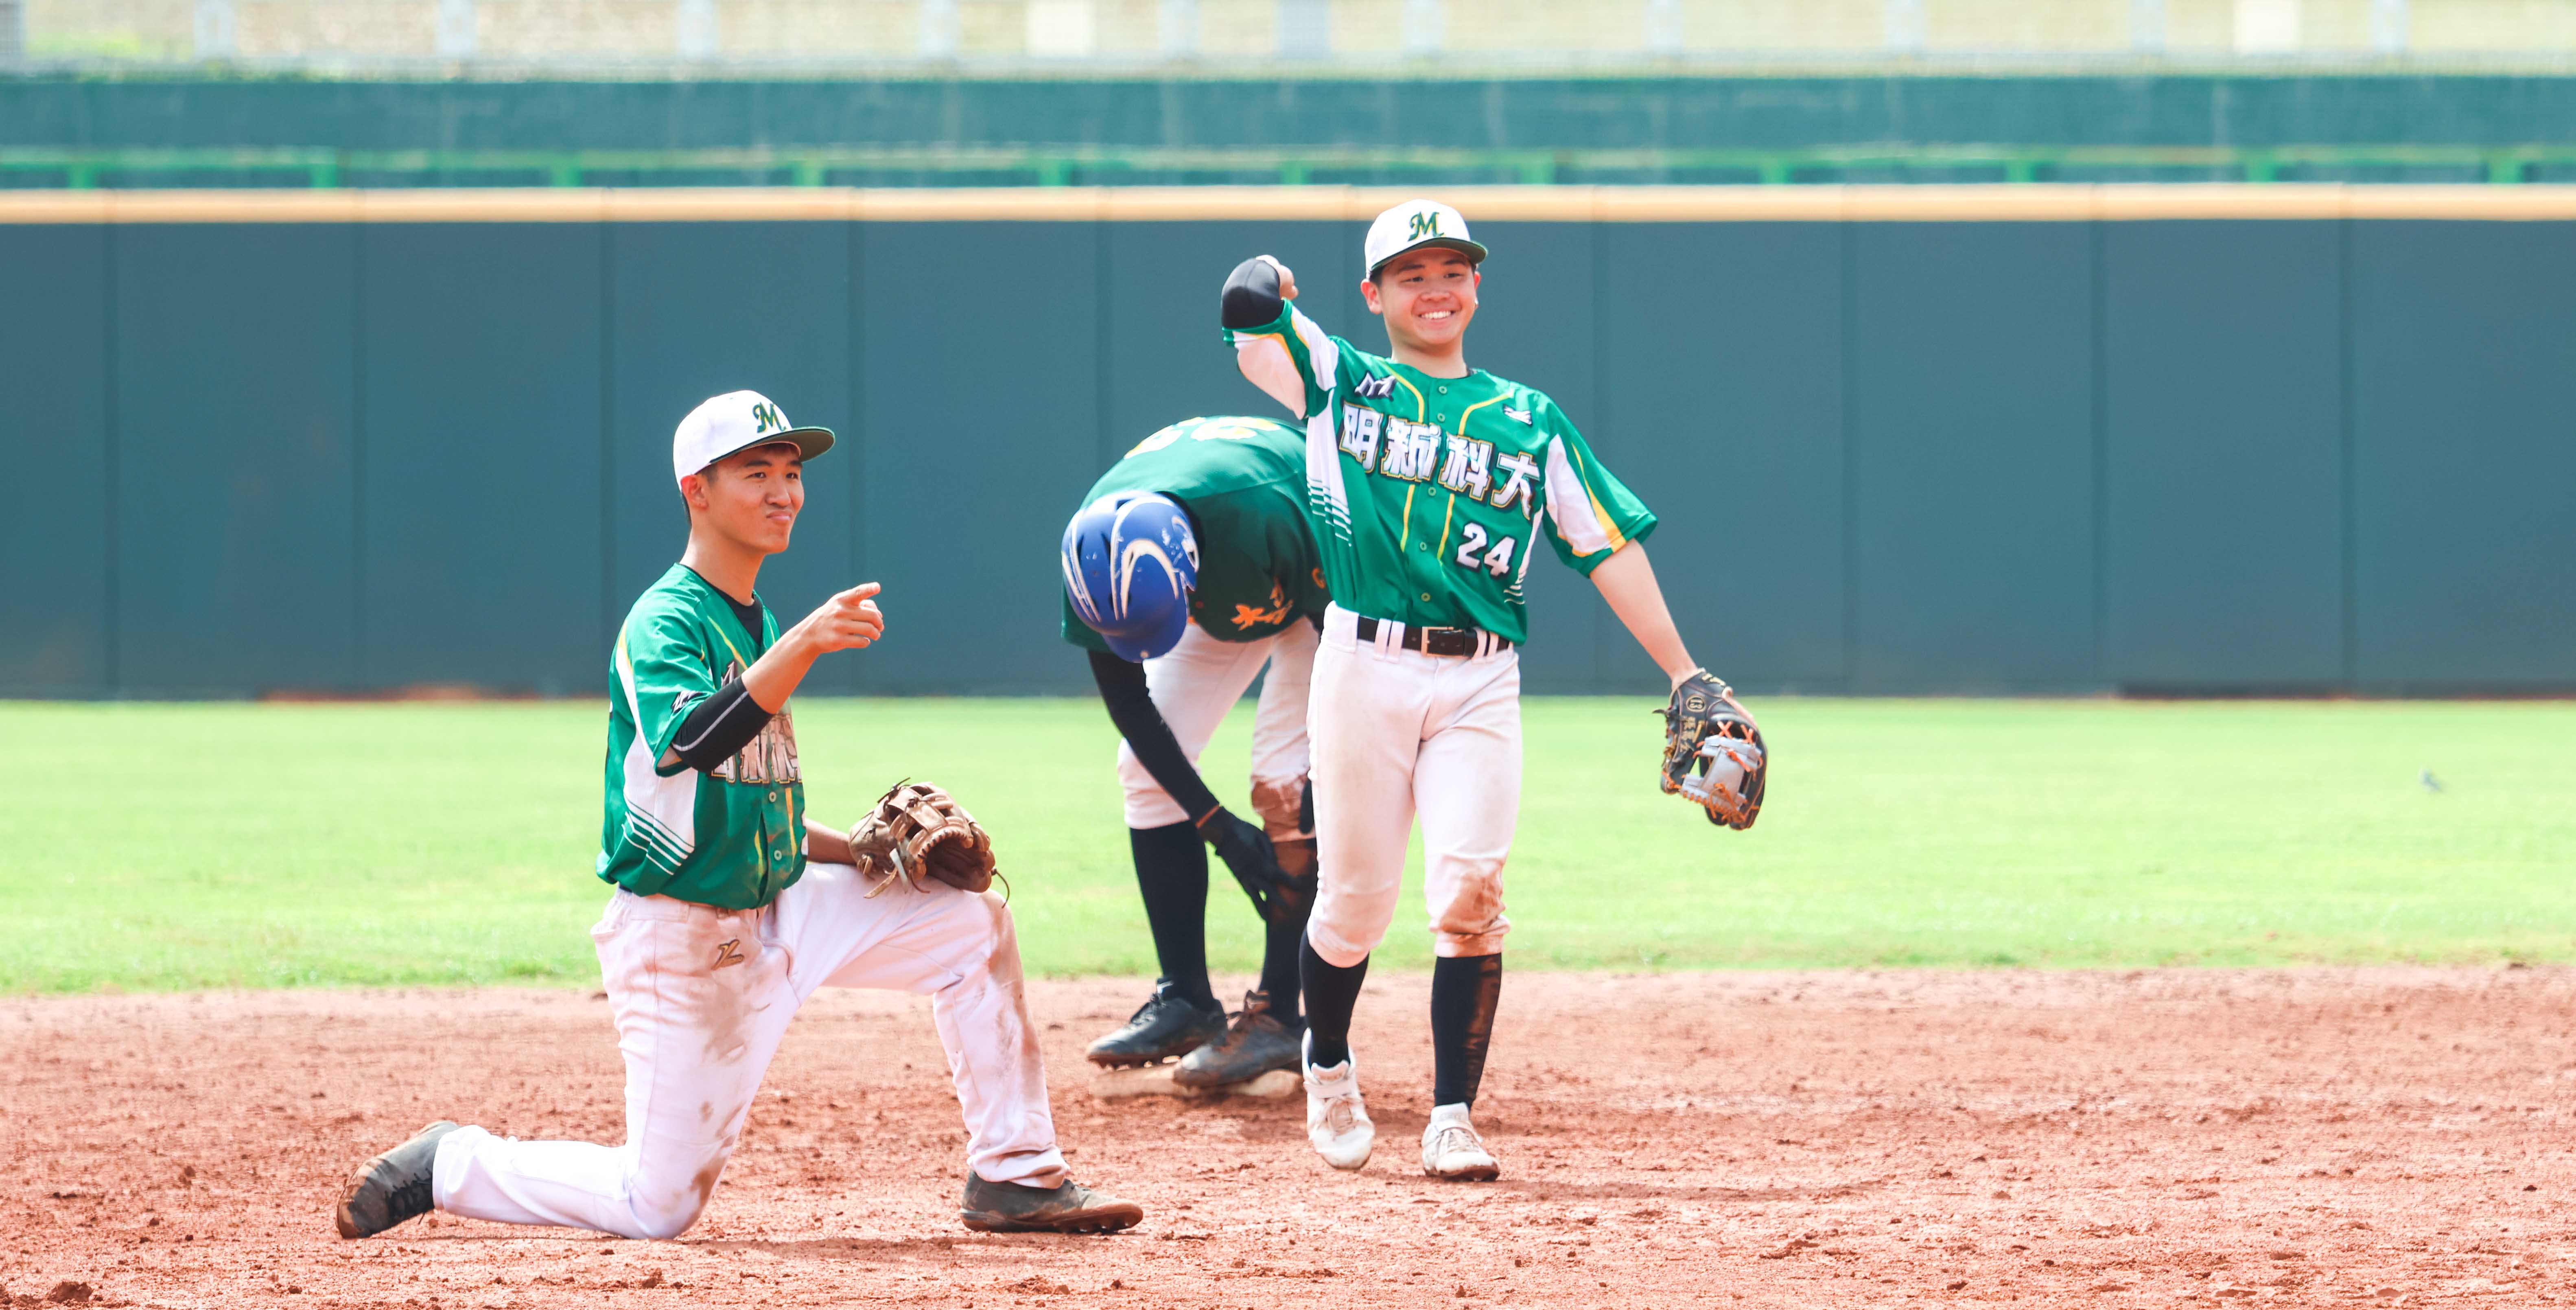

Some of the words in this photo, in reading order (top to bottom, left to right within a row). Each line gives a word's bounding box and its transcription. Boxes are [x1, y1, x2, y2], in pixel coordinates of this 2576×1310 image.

[1408, 211, 1445, 242] M
[752, 401, 787, 434] M
[1339, 401, 1541, 520] 明新科大
[1455, 521, 1516, 577] 24
